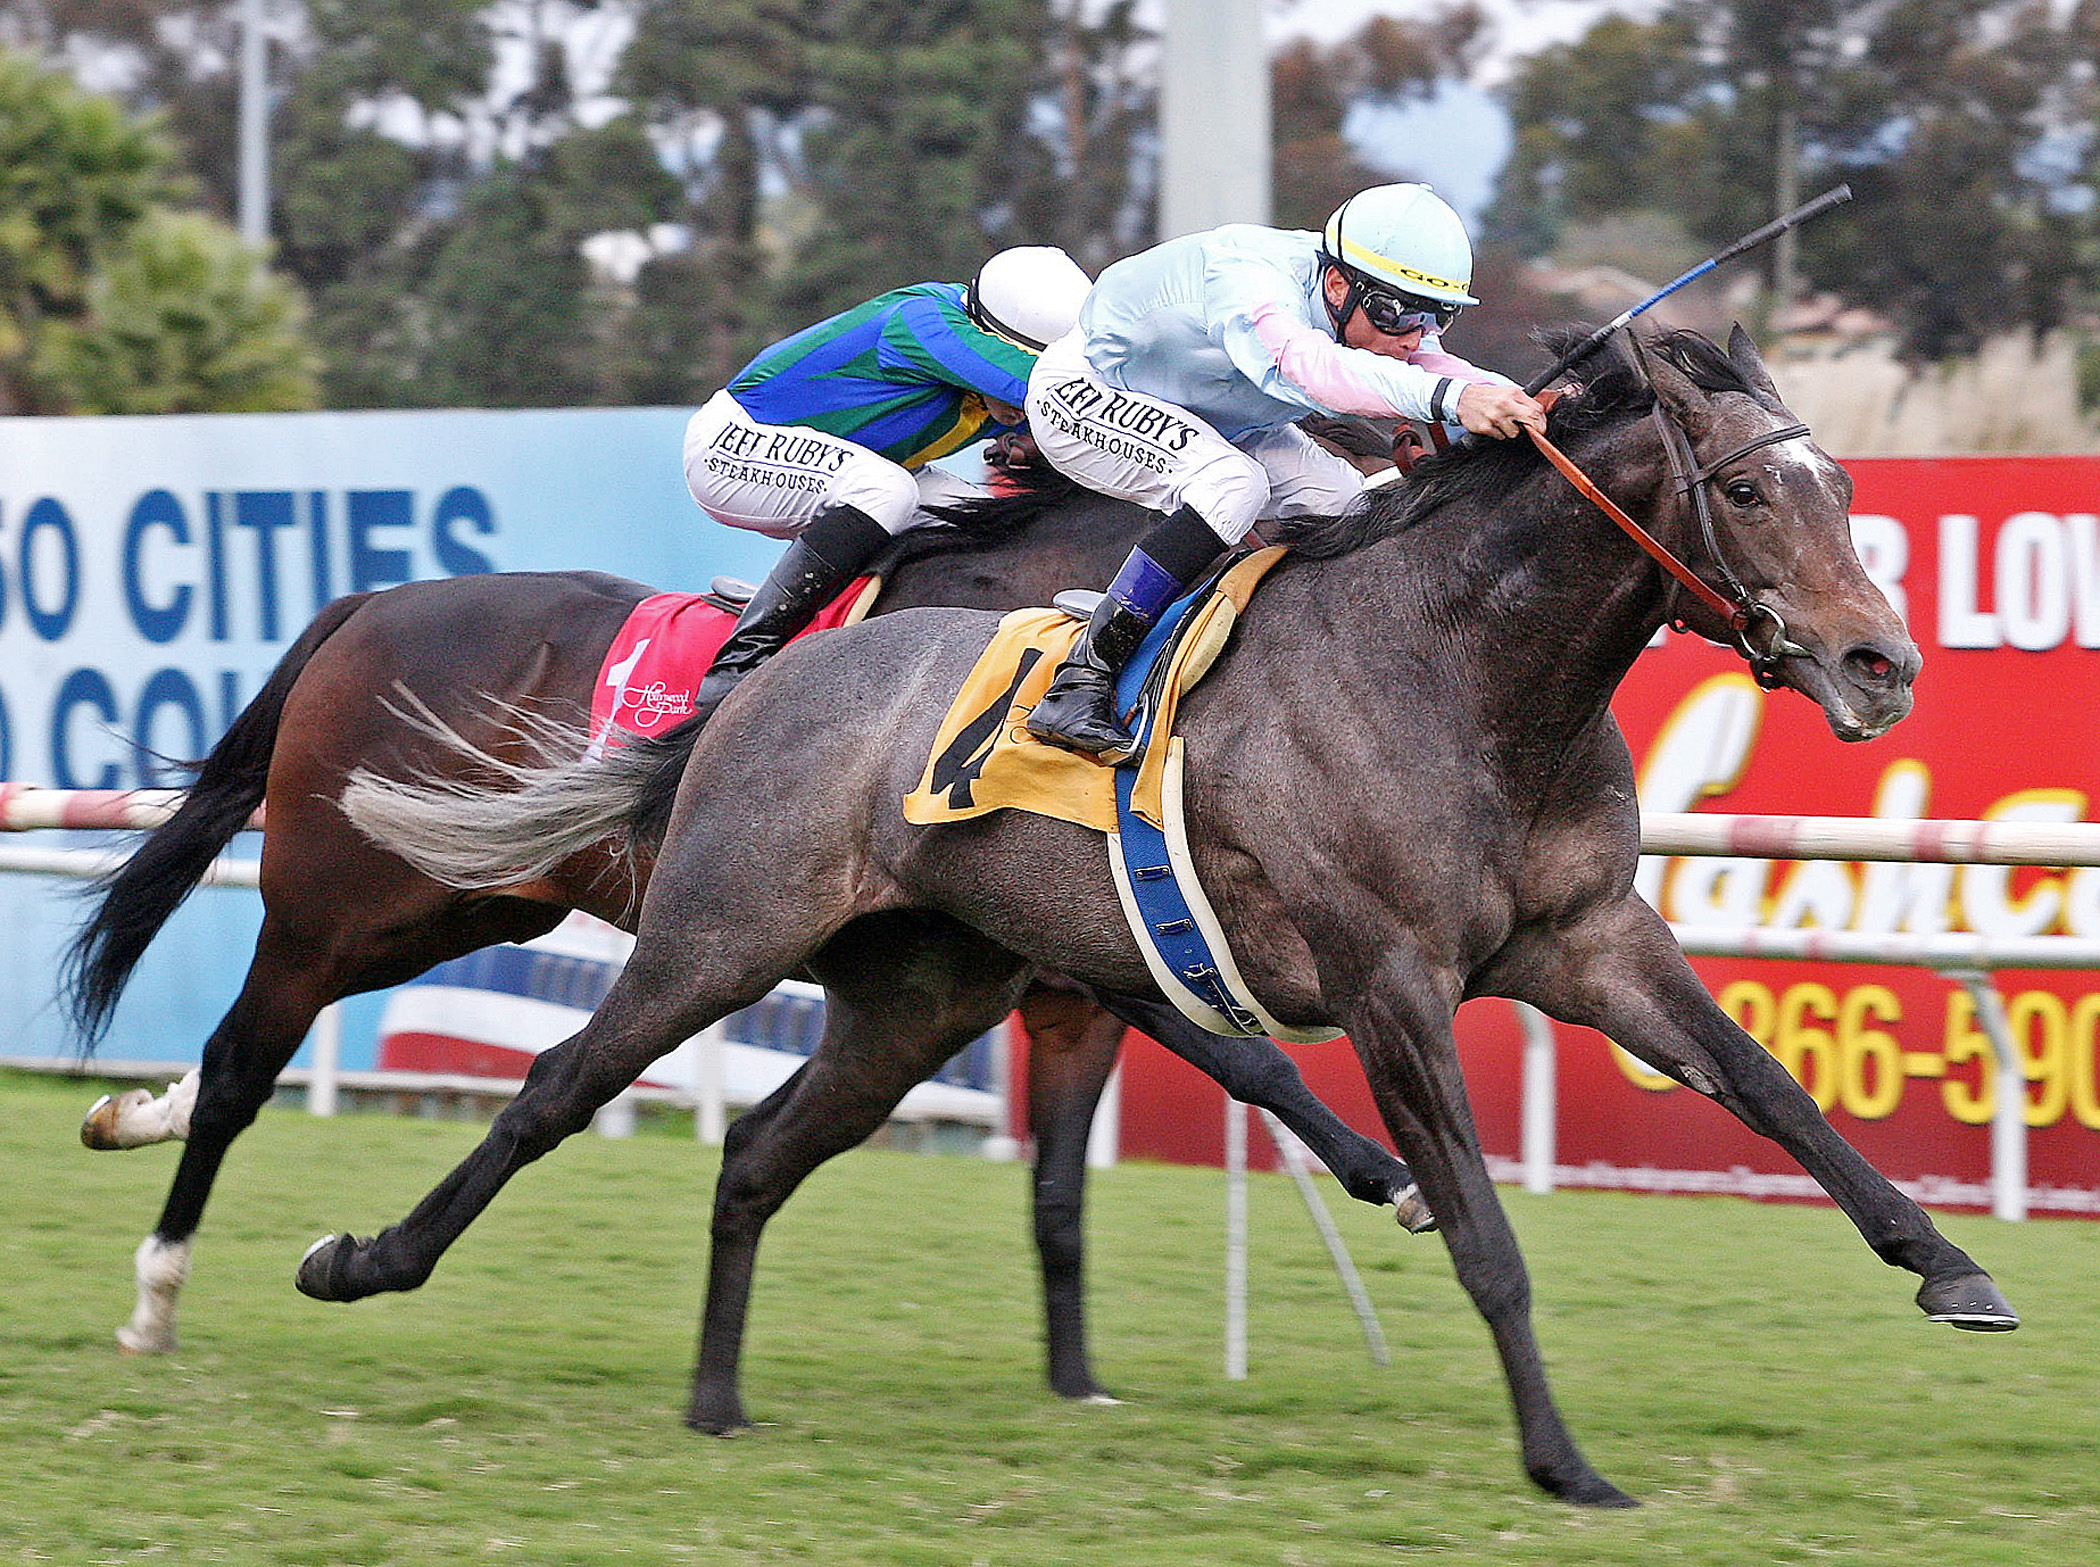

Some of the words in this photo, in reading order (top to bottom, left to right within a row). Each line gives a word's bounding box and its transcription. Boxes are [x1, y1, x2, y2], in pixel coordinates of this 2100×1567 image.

[765, 433, 854, 472] RUBY'S
[1045, 377, 1103, 416] EF
[1099, 392, 1199, 450] RUBY'S
[121, 487, 500, 643] CITIES
[930, 648, 1044, 808] 4
